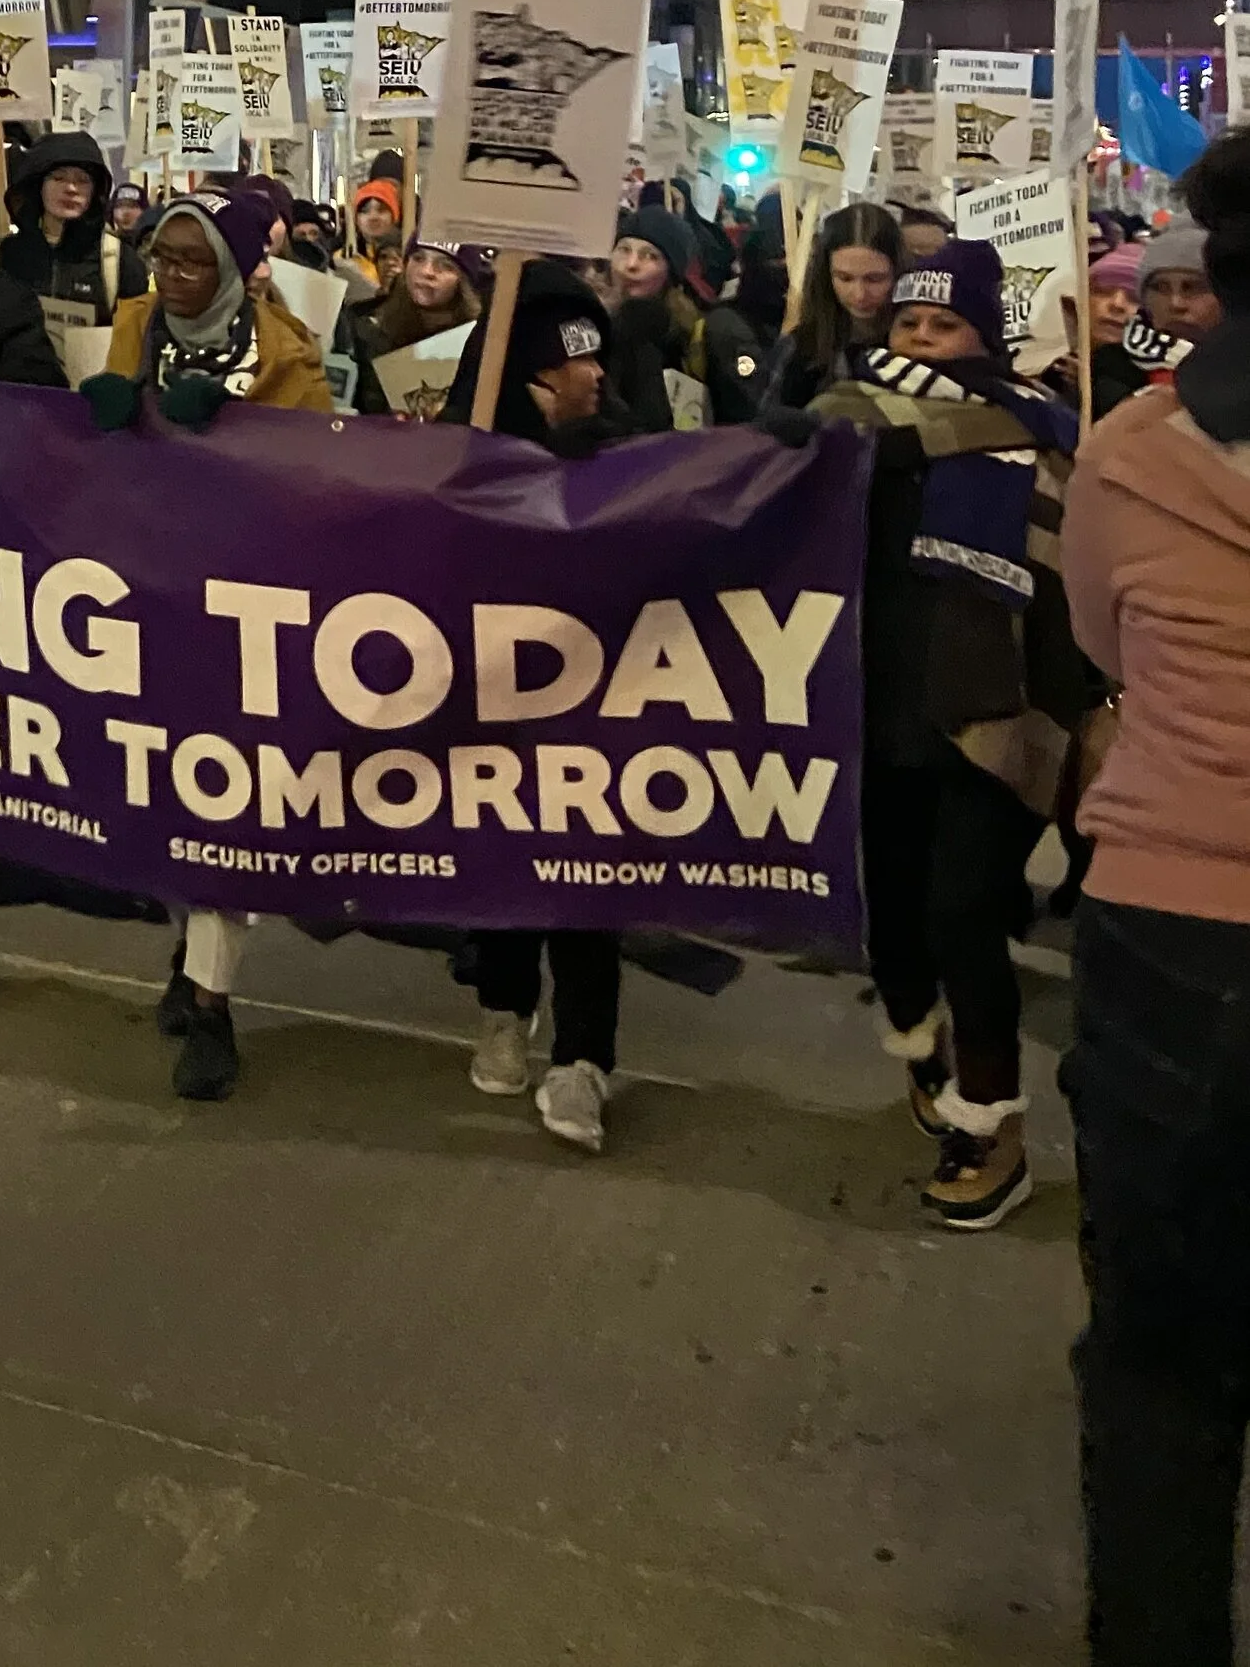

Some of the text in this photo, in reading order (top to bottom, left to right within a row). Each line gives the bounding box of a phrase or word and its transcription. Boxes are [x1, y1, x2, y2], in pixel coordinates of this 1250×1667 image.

[861, 9, 888, 25] TODAY
[232, 19, 280, 31] I STAND
[834, 26, 858, 41] FOR A
[379, 61, 422, 75] SEIU
[950, 59, 1020, 70] FIGHTING TODAY
[193, 74, 205, 82] FOR
[379, 76, 419, 84] LOCAL 26
[970, 72, 994, 81] FOR A
[243, 95, 269, 109] SEIU
[806, 113, 844, 134] SEIU
[182, 128, 212, 140] SEIU
[957, 131, 994, 145] SEIU
[969, 182, 1050, 218] FIGHTING TODAY
[994, 208, 1021, 229] FOR A
[1003, 301, 1031, 325] EIU
[205, 578, 845, 730] TODAY
[105, 718, 839, 845] TOMORROW
[169, 836, 457, 877] SECURITY OFFICERS
[533, 858, 830, 897] WINDOW WASHERS
